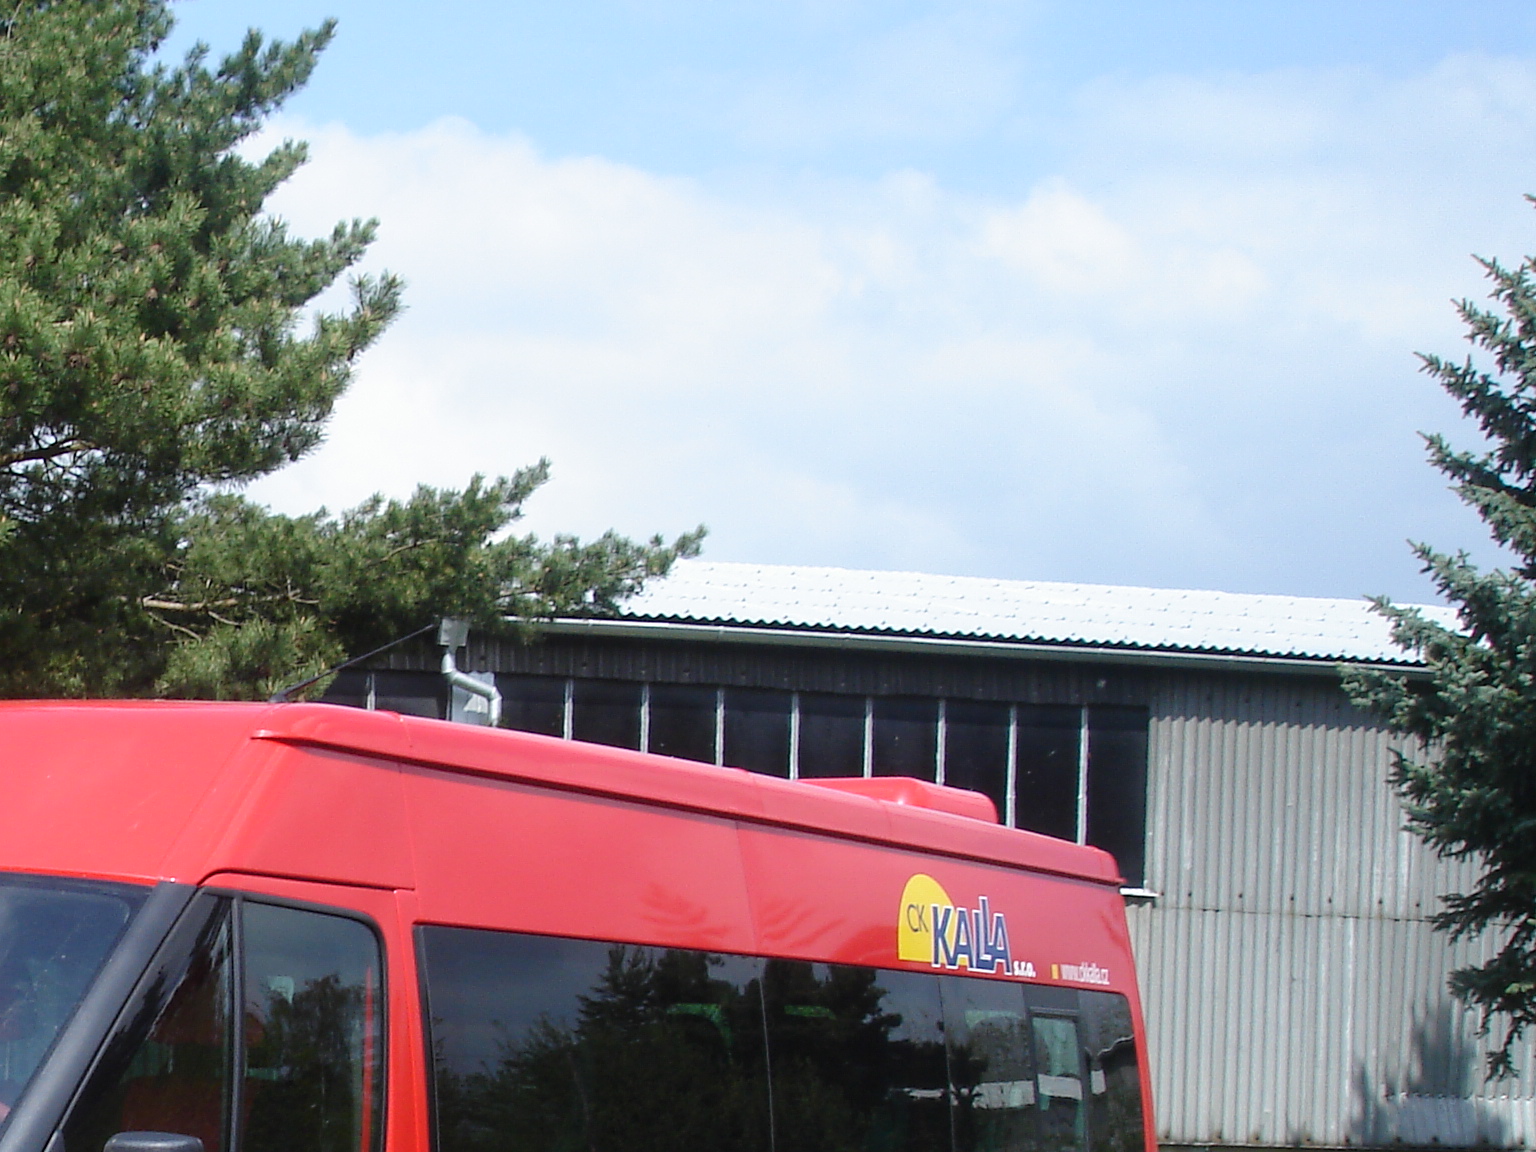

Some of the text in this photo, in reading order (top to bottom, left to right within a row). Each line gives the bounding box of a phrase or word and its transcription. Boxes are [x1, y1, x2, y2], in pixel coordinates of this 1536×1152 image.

[906, 895, 1037, 978] CK KALLA s.r.o.
